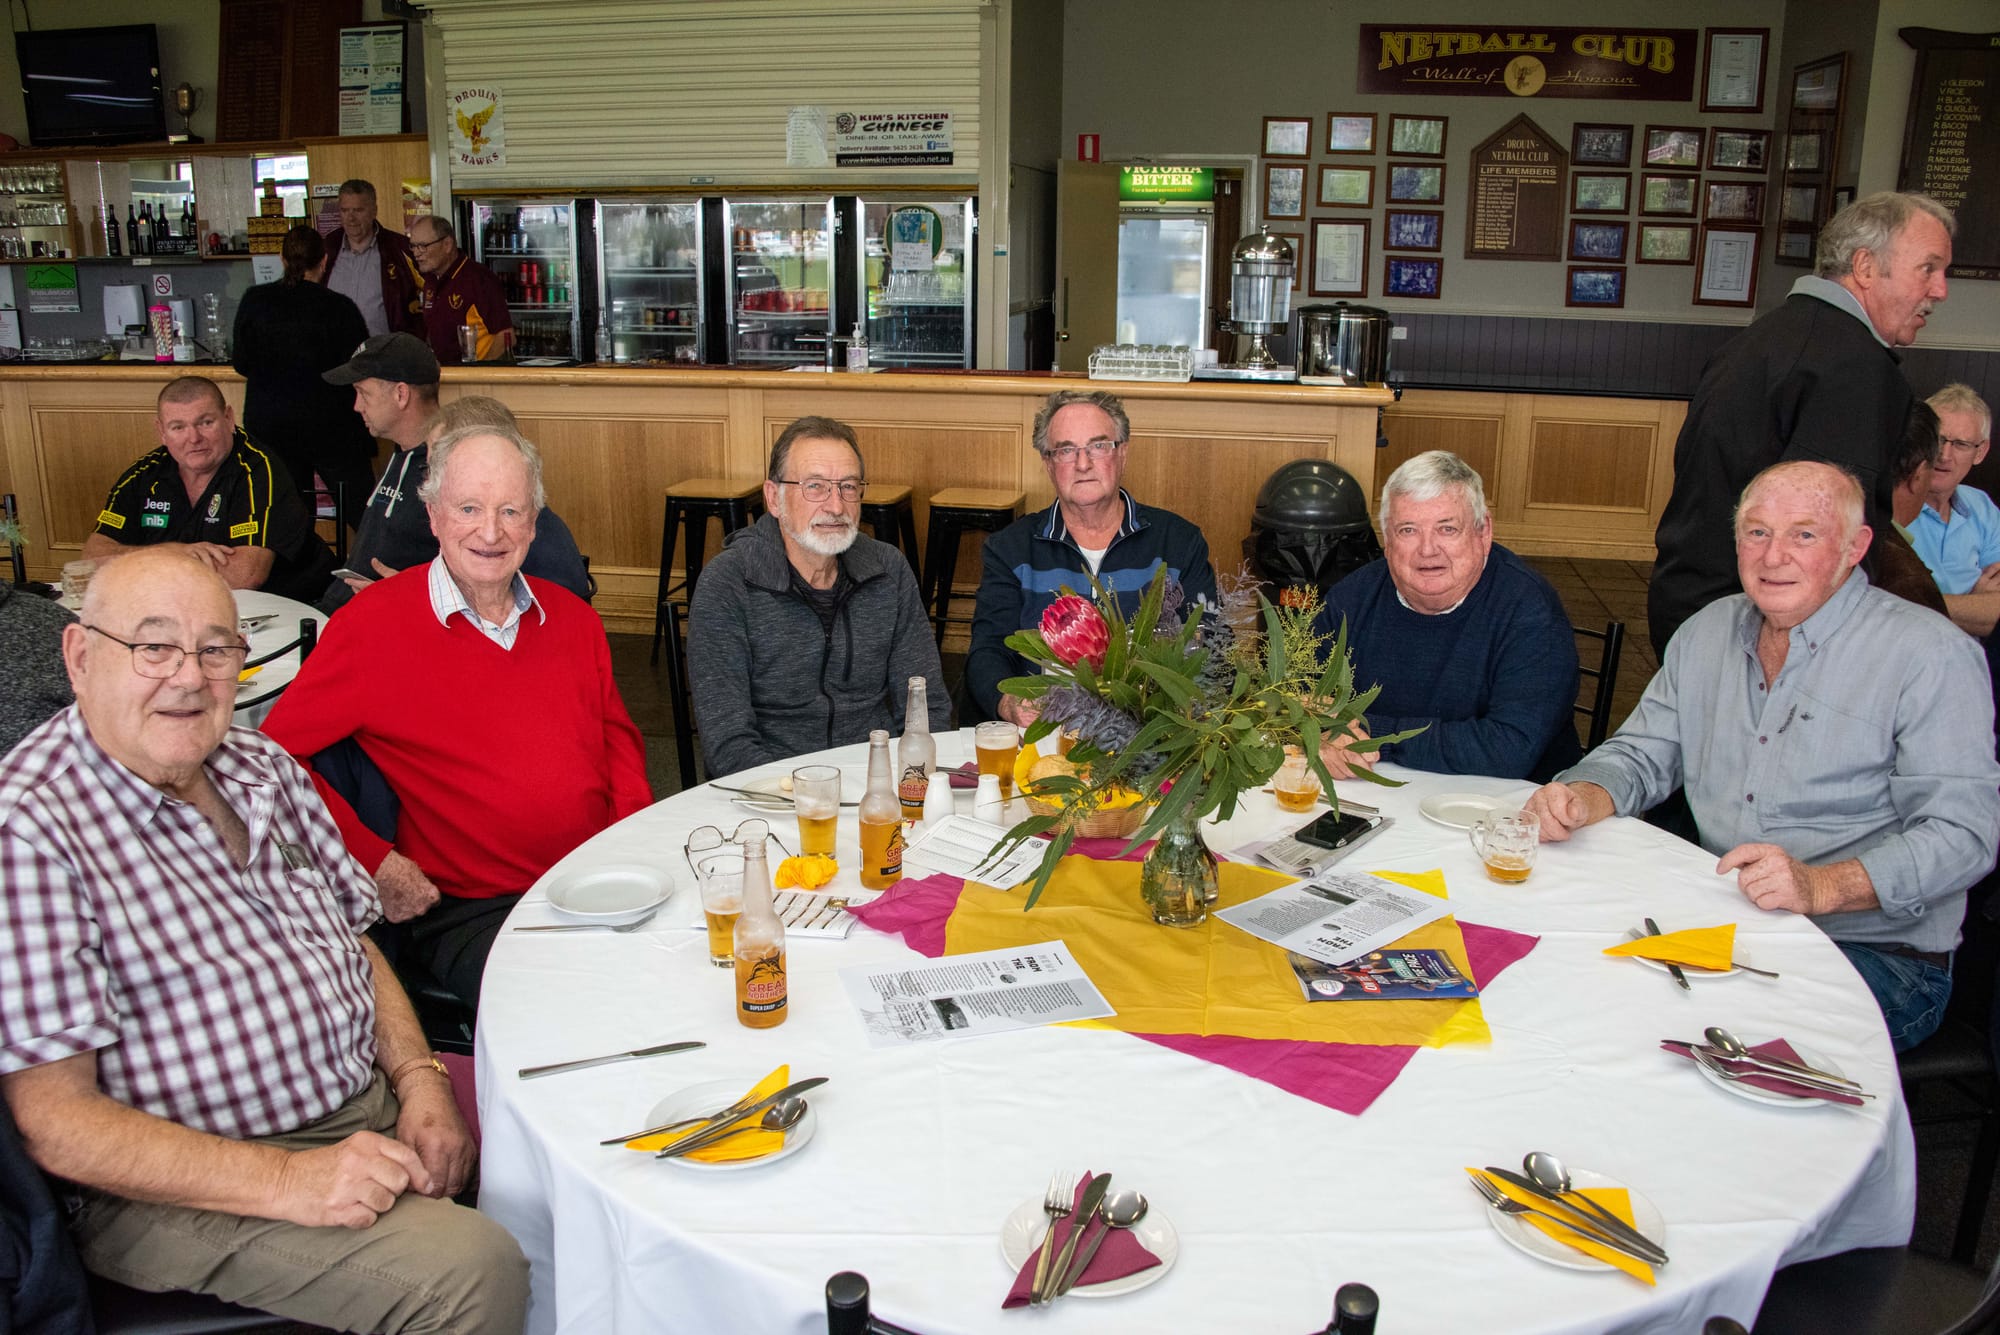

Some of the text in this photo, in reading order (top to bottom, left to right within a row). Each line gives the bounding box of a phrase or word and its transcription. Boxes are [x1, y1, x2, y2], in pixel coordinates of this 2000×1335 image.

[1378, 32, 1557, 70] NETBALL
[1571, 34, 1677, 74] CLUB
[1412, 66, 1638, 85] Wall of Honour
[454, 88, 498, 104] DROUIN
[897, 113, 949, 121] KITCHEN
[862, 121, 945, 132] CHINESE
[1506, 139, 1536, 149] DROUIN
[461, 152, 499, 165] HAWKS
[840, 156, 950, 165] www.kimskitchendrouin.net.au
[1491, 151, 1550, 162] NETBALL CLUB
[1480, 167, 1557, 176] LIFE MEMBERS
[1132, 174, 1193, 186] BITTER
[143, 497, 171, 513] Jeep
[146, 514, 165, 527] nib
[1317, 937, 1347, 950] FROM
[1332, 936, 1354, 947] THE
[1010, 957, 1026, 971] THE
[1023, 955, 1042, 973] FROM
